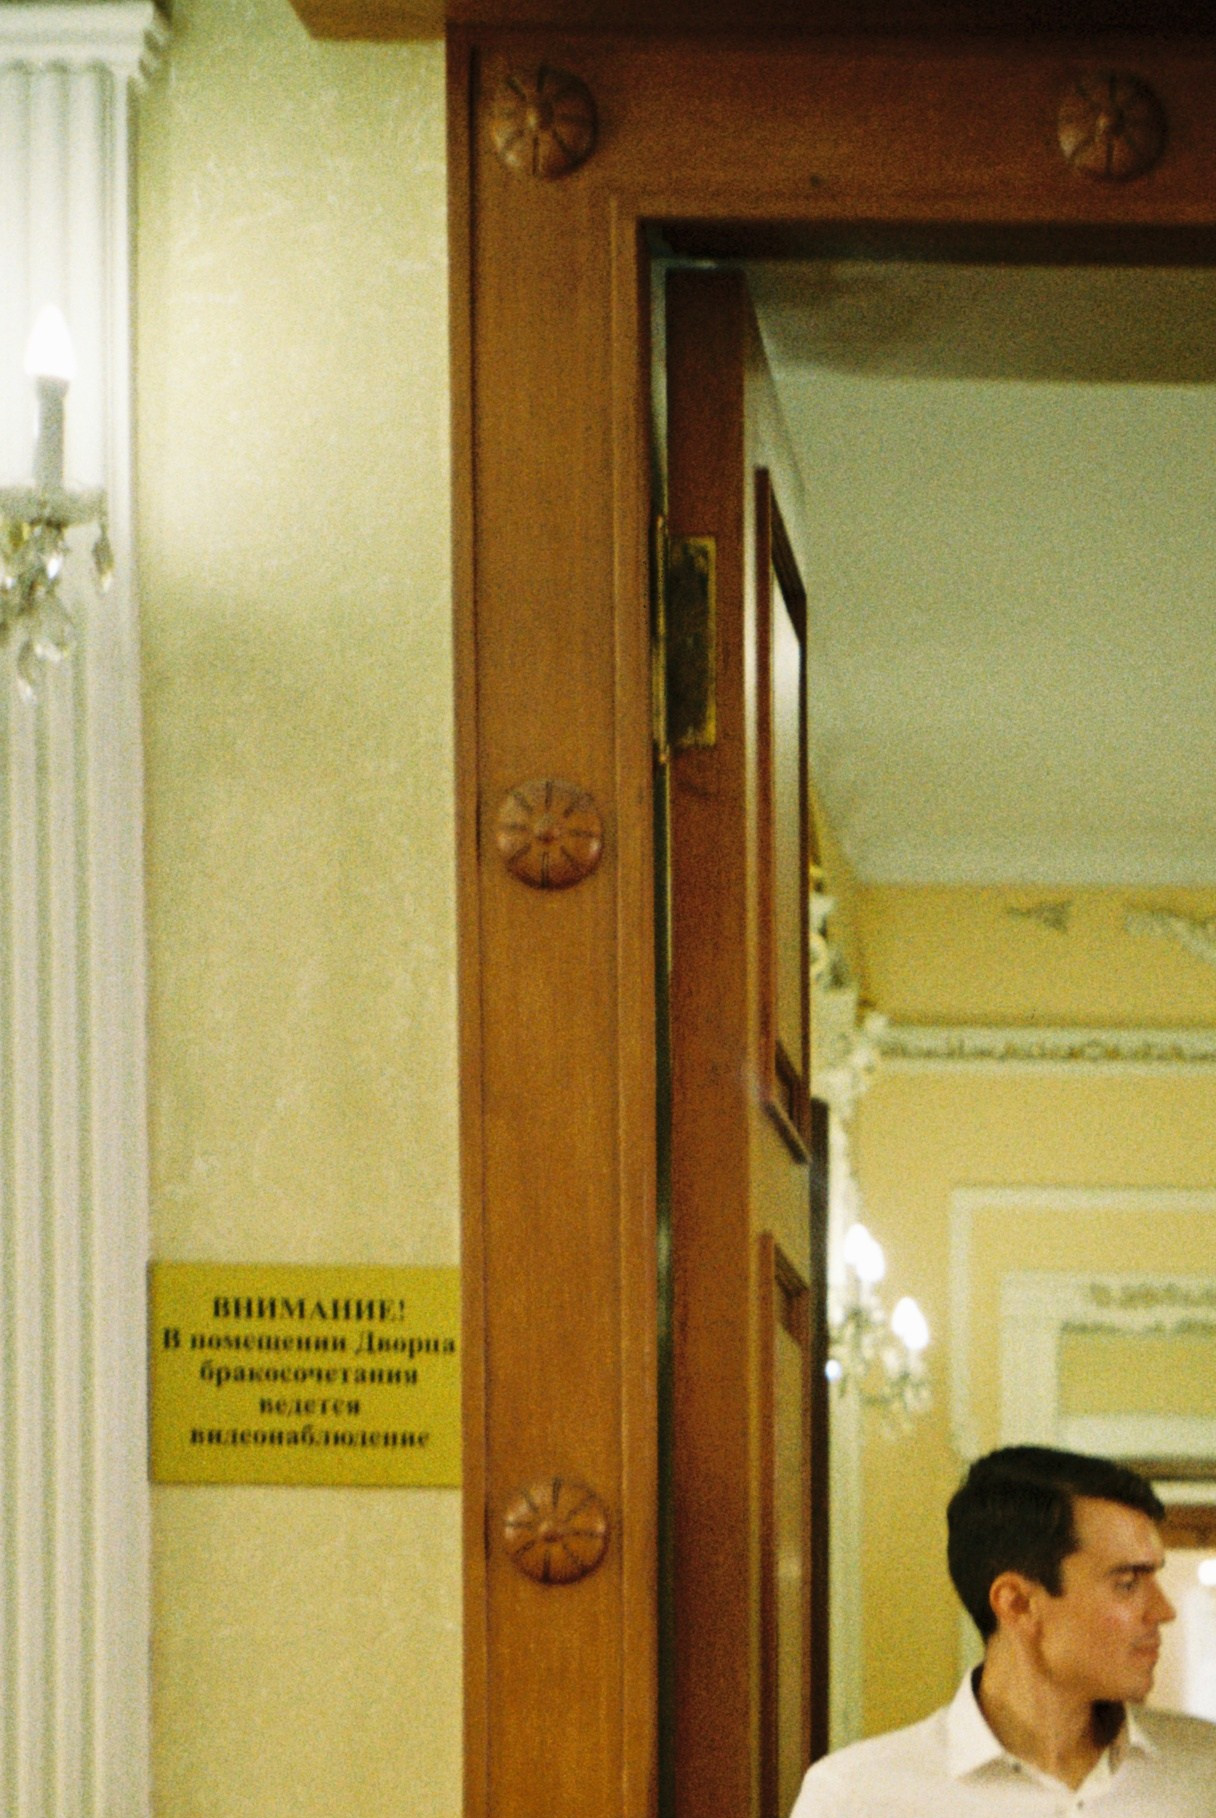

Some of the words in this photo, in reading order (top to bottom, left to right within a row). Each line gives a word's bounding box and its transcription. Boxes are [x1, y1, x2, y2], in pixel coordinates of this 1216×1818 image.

[212, 1295, 405, 1322] ВНИМАНИЕ!
[162, 1327, 181, 1350] В
[190, 1332, 346, 1351] помещении
[355, 1331, 455, 1359] Дворца
[199, 1359, 418, 1387] бракосочетания
[190, 1424, 428, 1448] видеонаблюдение
